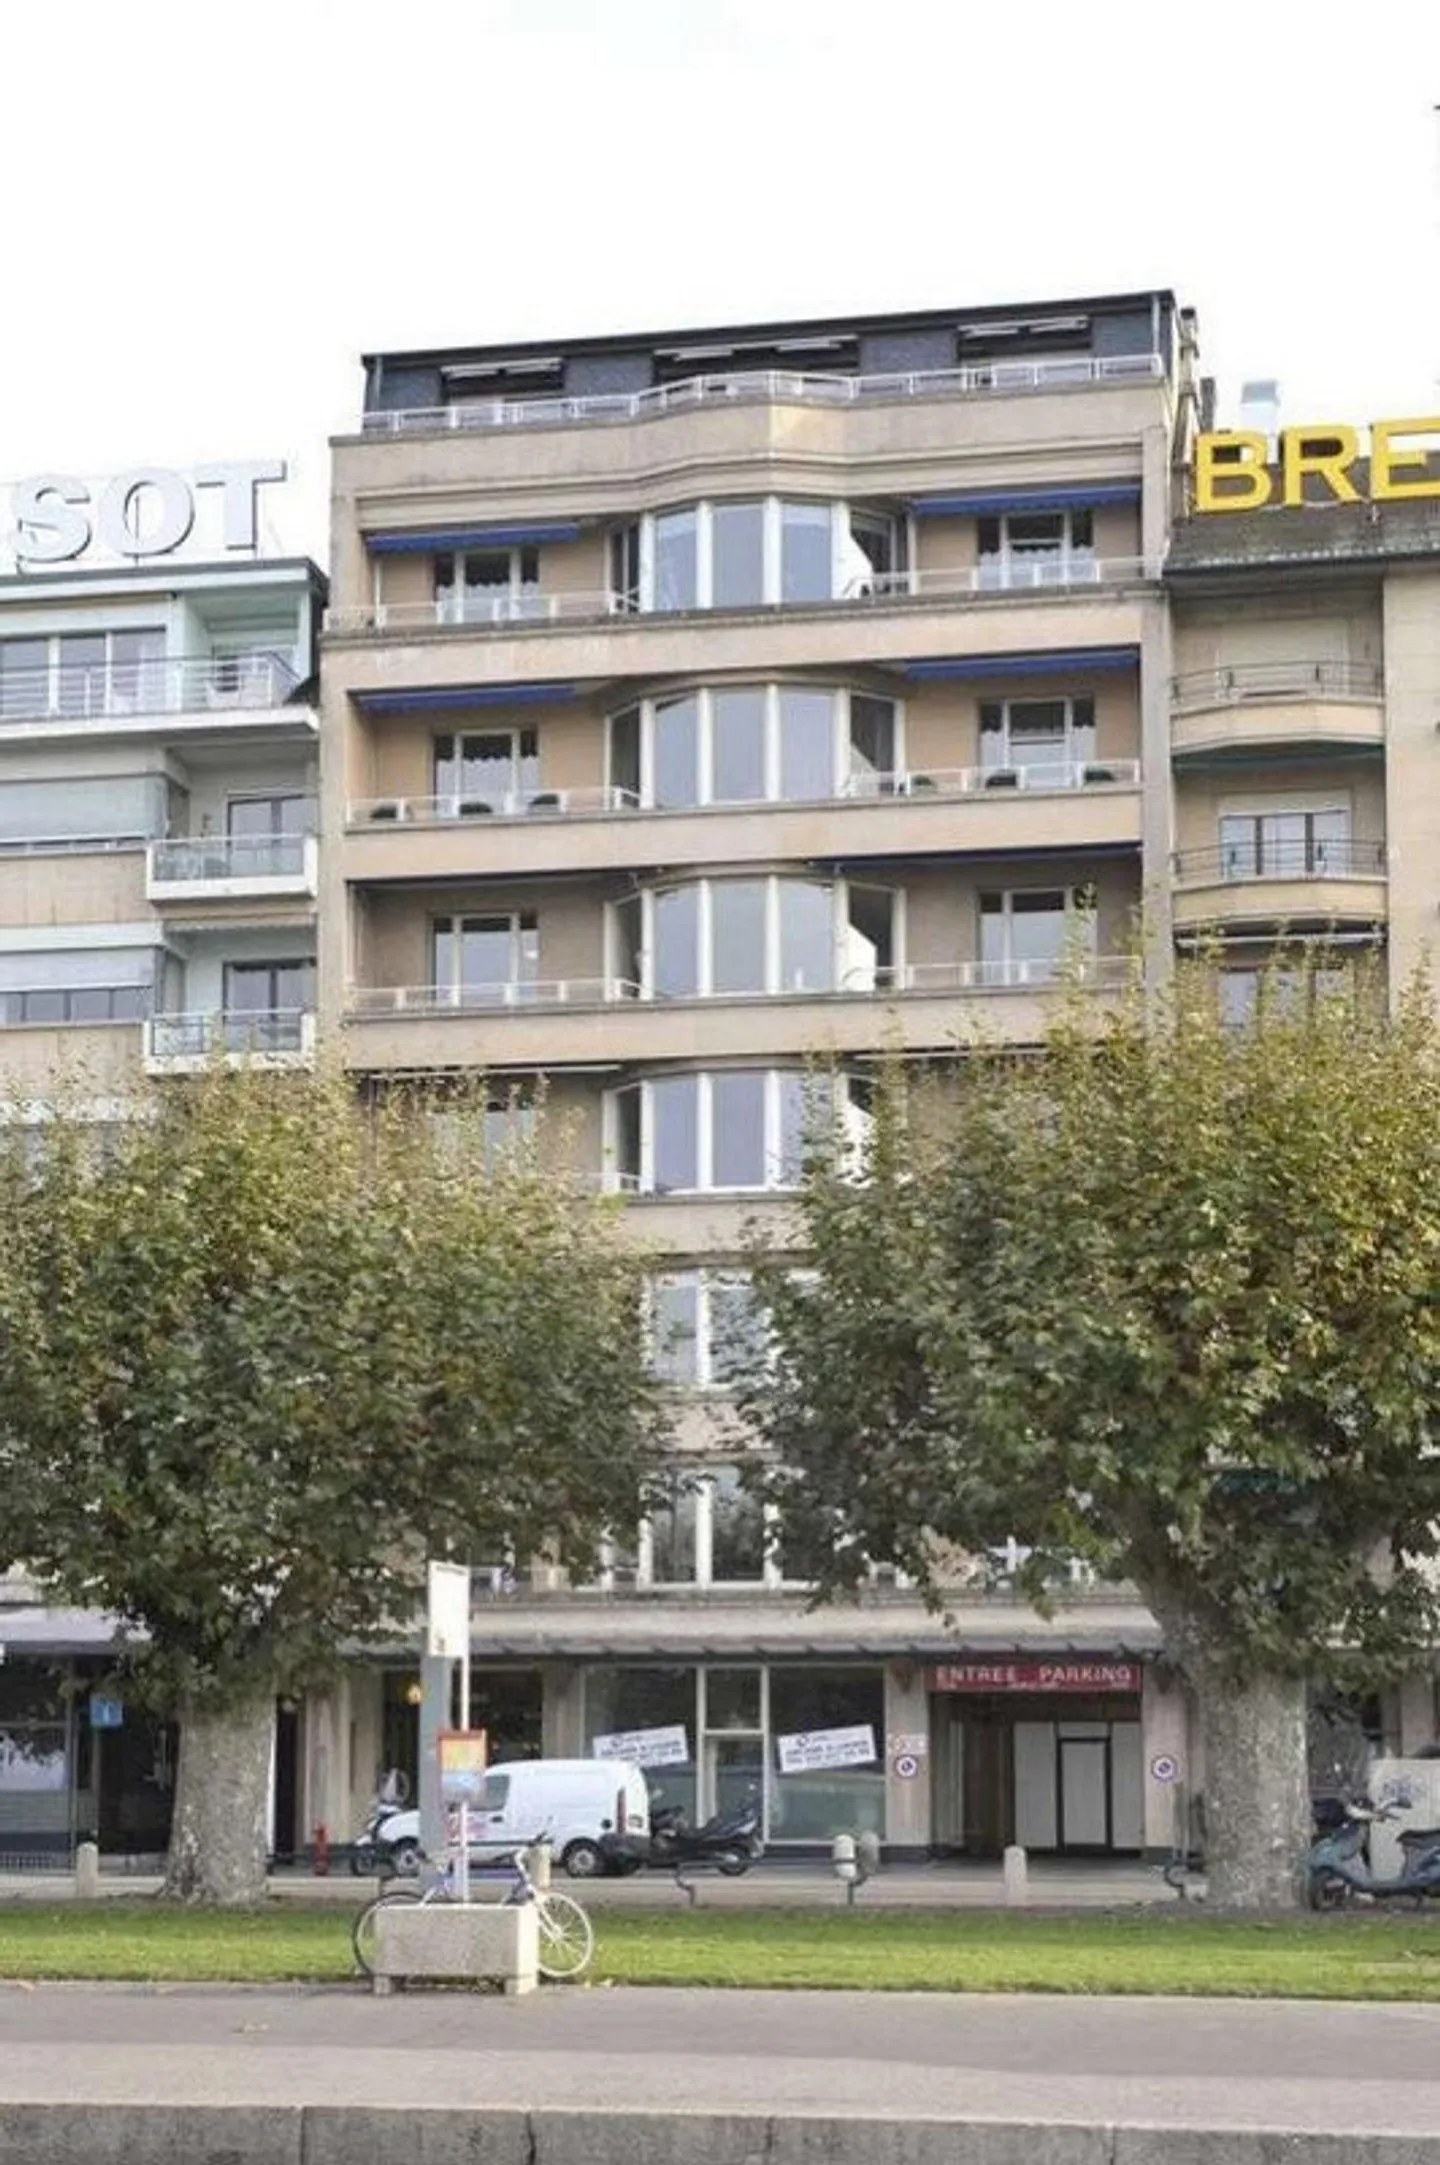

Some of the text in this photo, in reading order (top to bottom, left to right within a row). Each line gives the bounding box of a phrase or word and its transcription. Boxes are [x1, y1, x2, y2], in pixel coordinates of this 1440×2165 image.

[11, 459, 287, 564] SOT
[1194, 417, 1440, 515] BRE
[935, 1664, 1132, 1683] ENTREE PARKING
